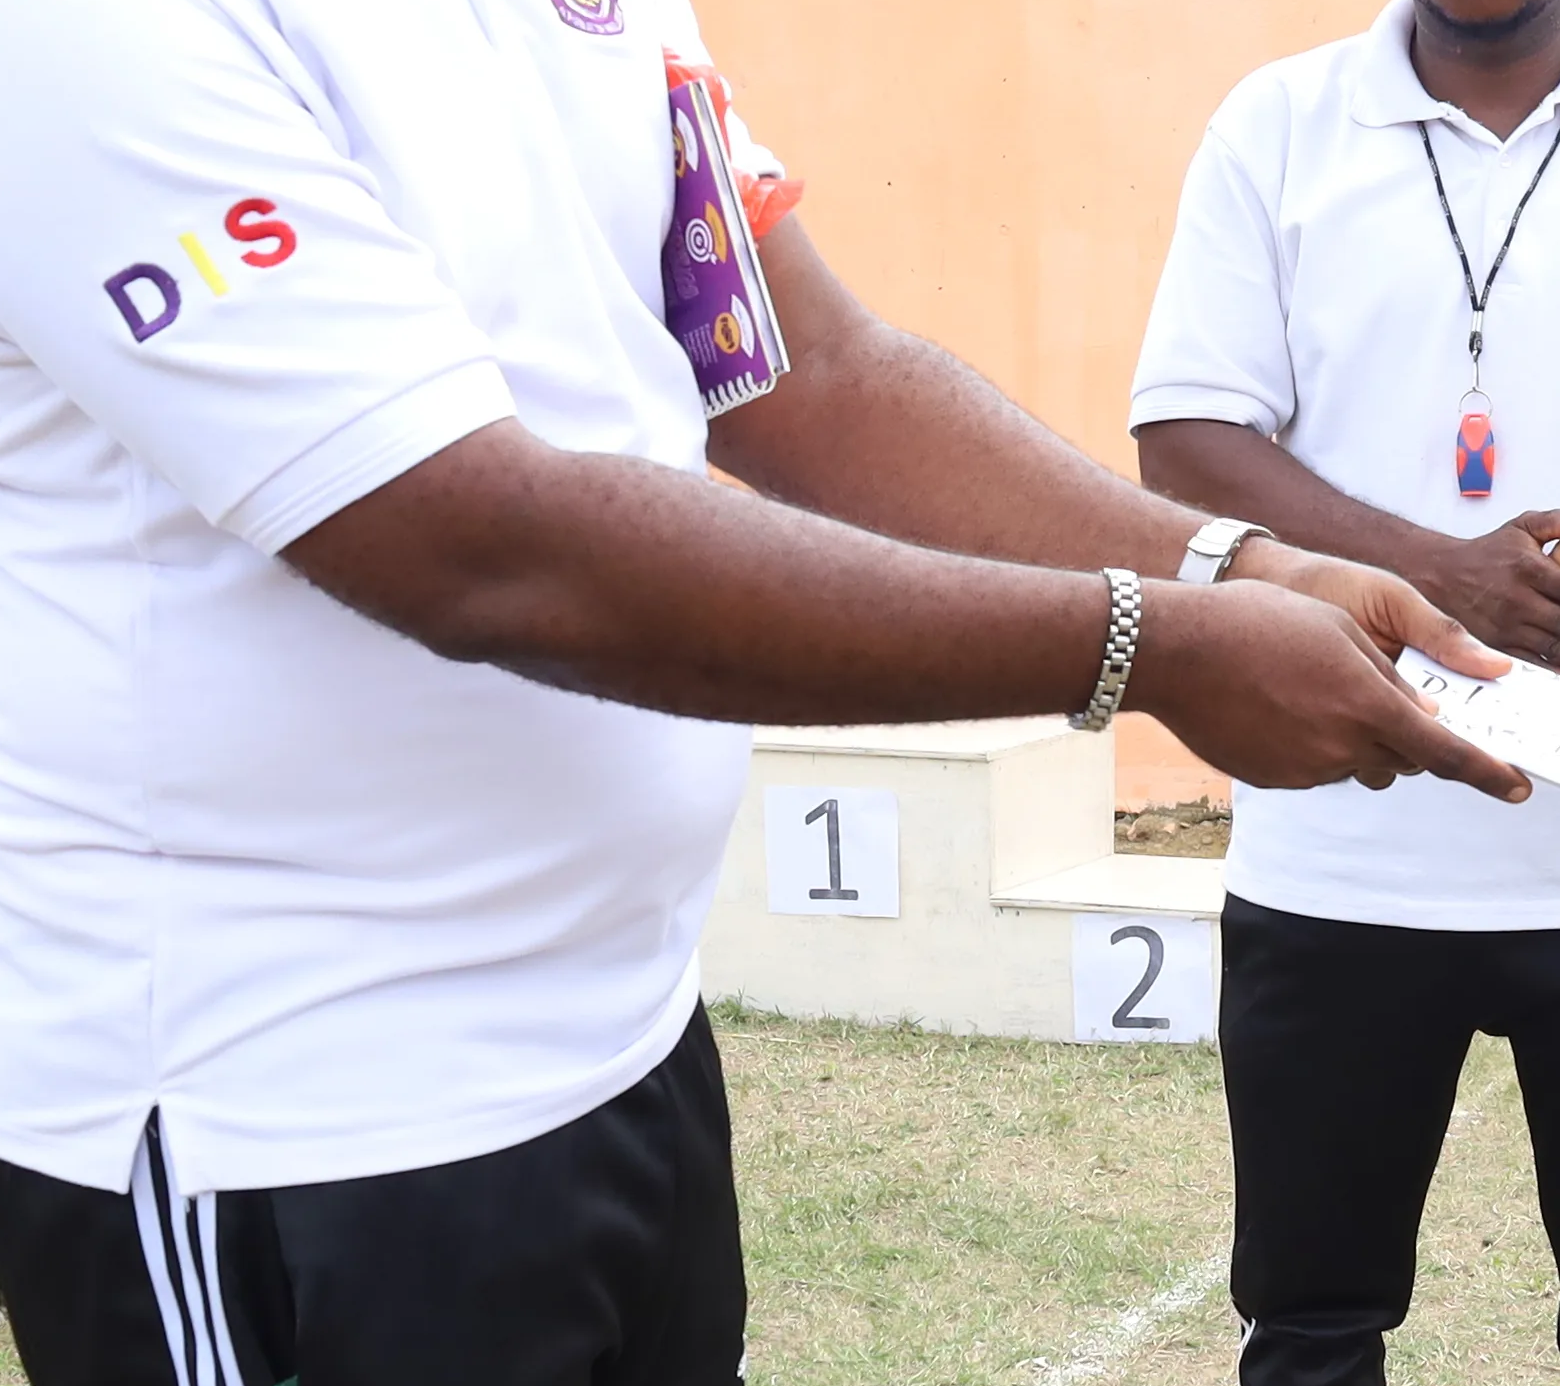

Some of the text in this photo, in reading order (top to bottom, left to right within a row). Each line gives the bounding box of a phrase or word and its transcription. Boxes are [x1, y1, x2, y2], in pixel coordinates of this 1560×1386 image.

[103, 197, 297, 344] DIS
[805, 799, 859, 900] 1
[1110, 925, 1170, 1029] 2
